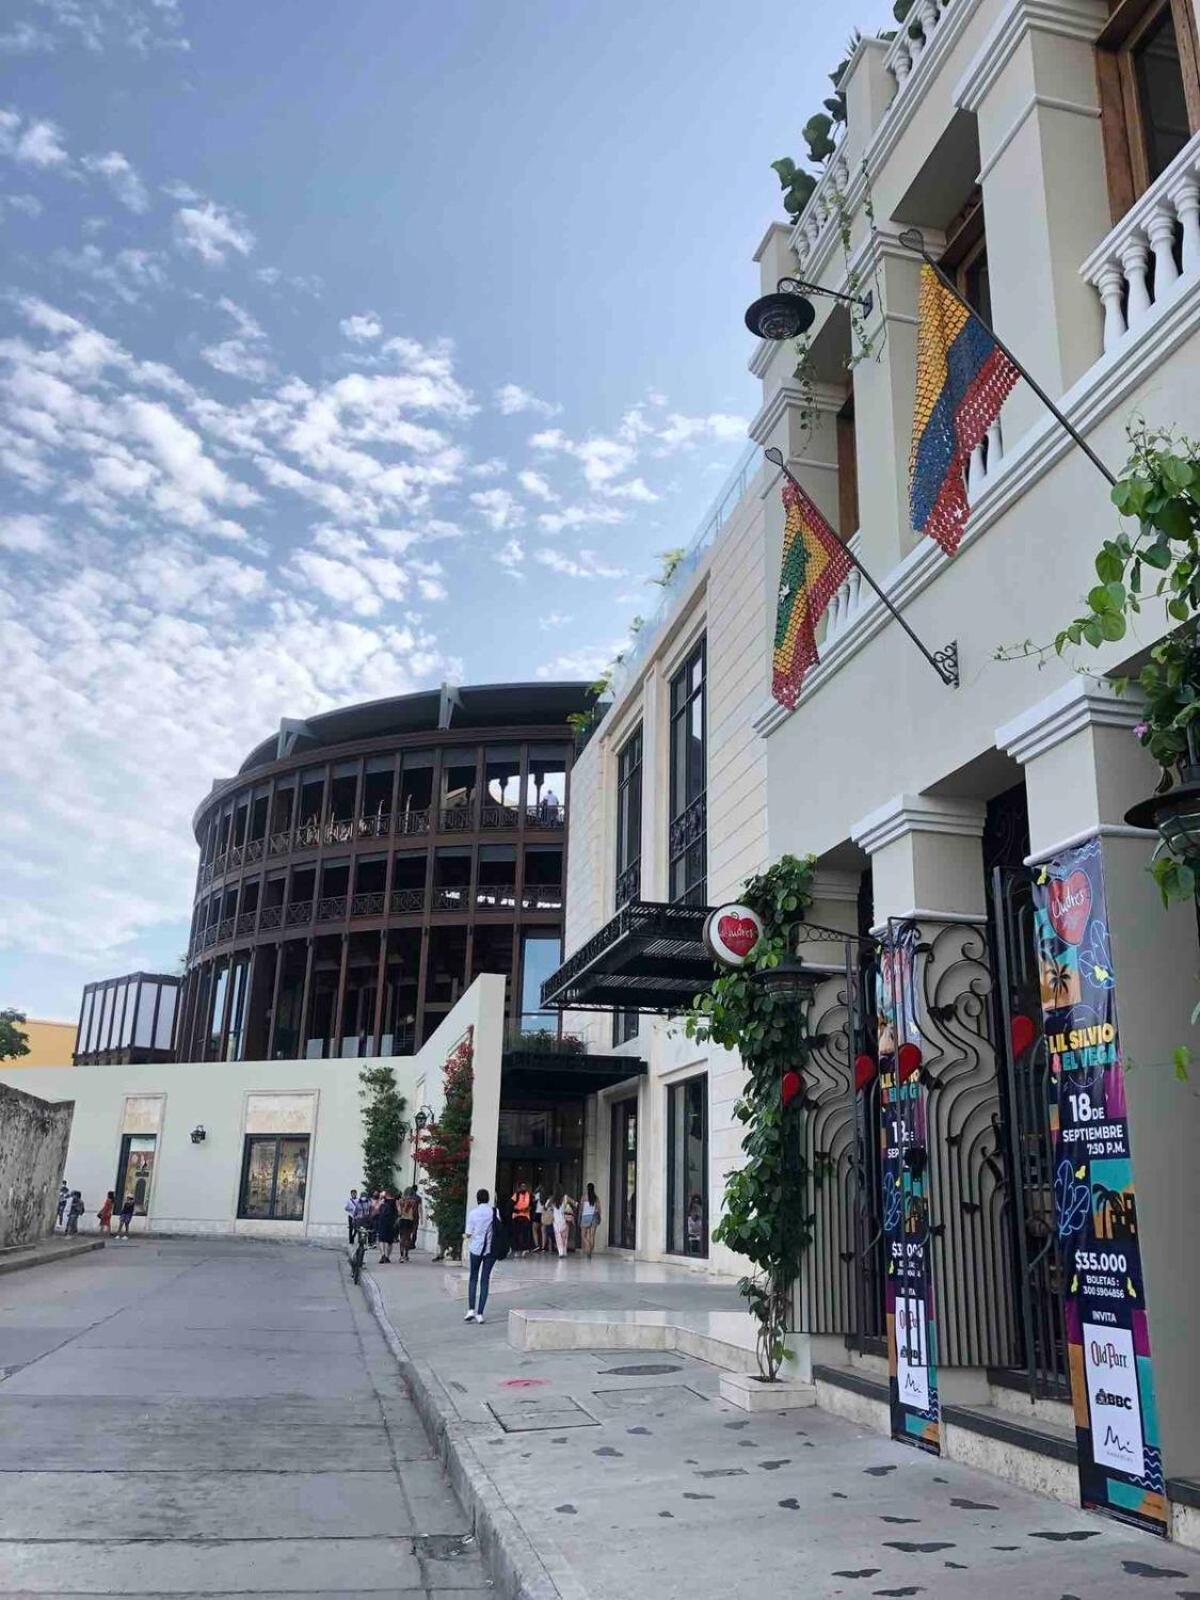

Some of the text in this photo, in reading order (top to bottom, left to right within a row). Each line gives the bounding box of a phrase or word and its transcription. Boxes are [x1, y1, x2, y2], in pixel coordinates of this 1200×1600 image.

[1049, 1023, 1114, 1054] LIL SILVIO
[1062, 1051, 1079, 1071] EL
[1069, 1093, 1105, 1122] 18 DE
[1062, 1125, 1123, 1142] SEPTIEMBRE
[1106, 1141, 1126, 1154] P.M.
[1075, 1249, 1127, 1273] $35.000
[1092, 1310, 1118, 1323] INVITA
[1106, 1392, 1133, 1410] BBC
